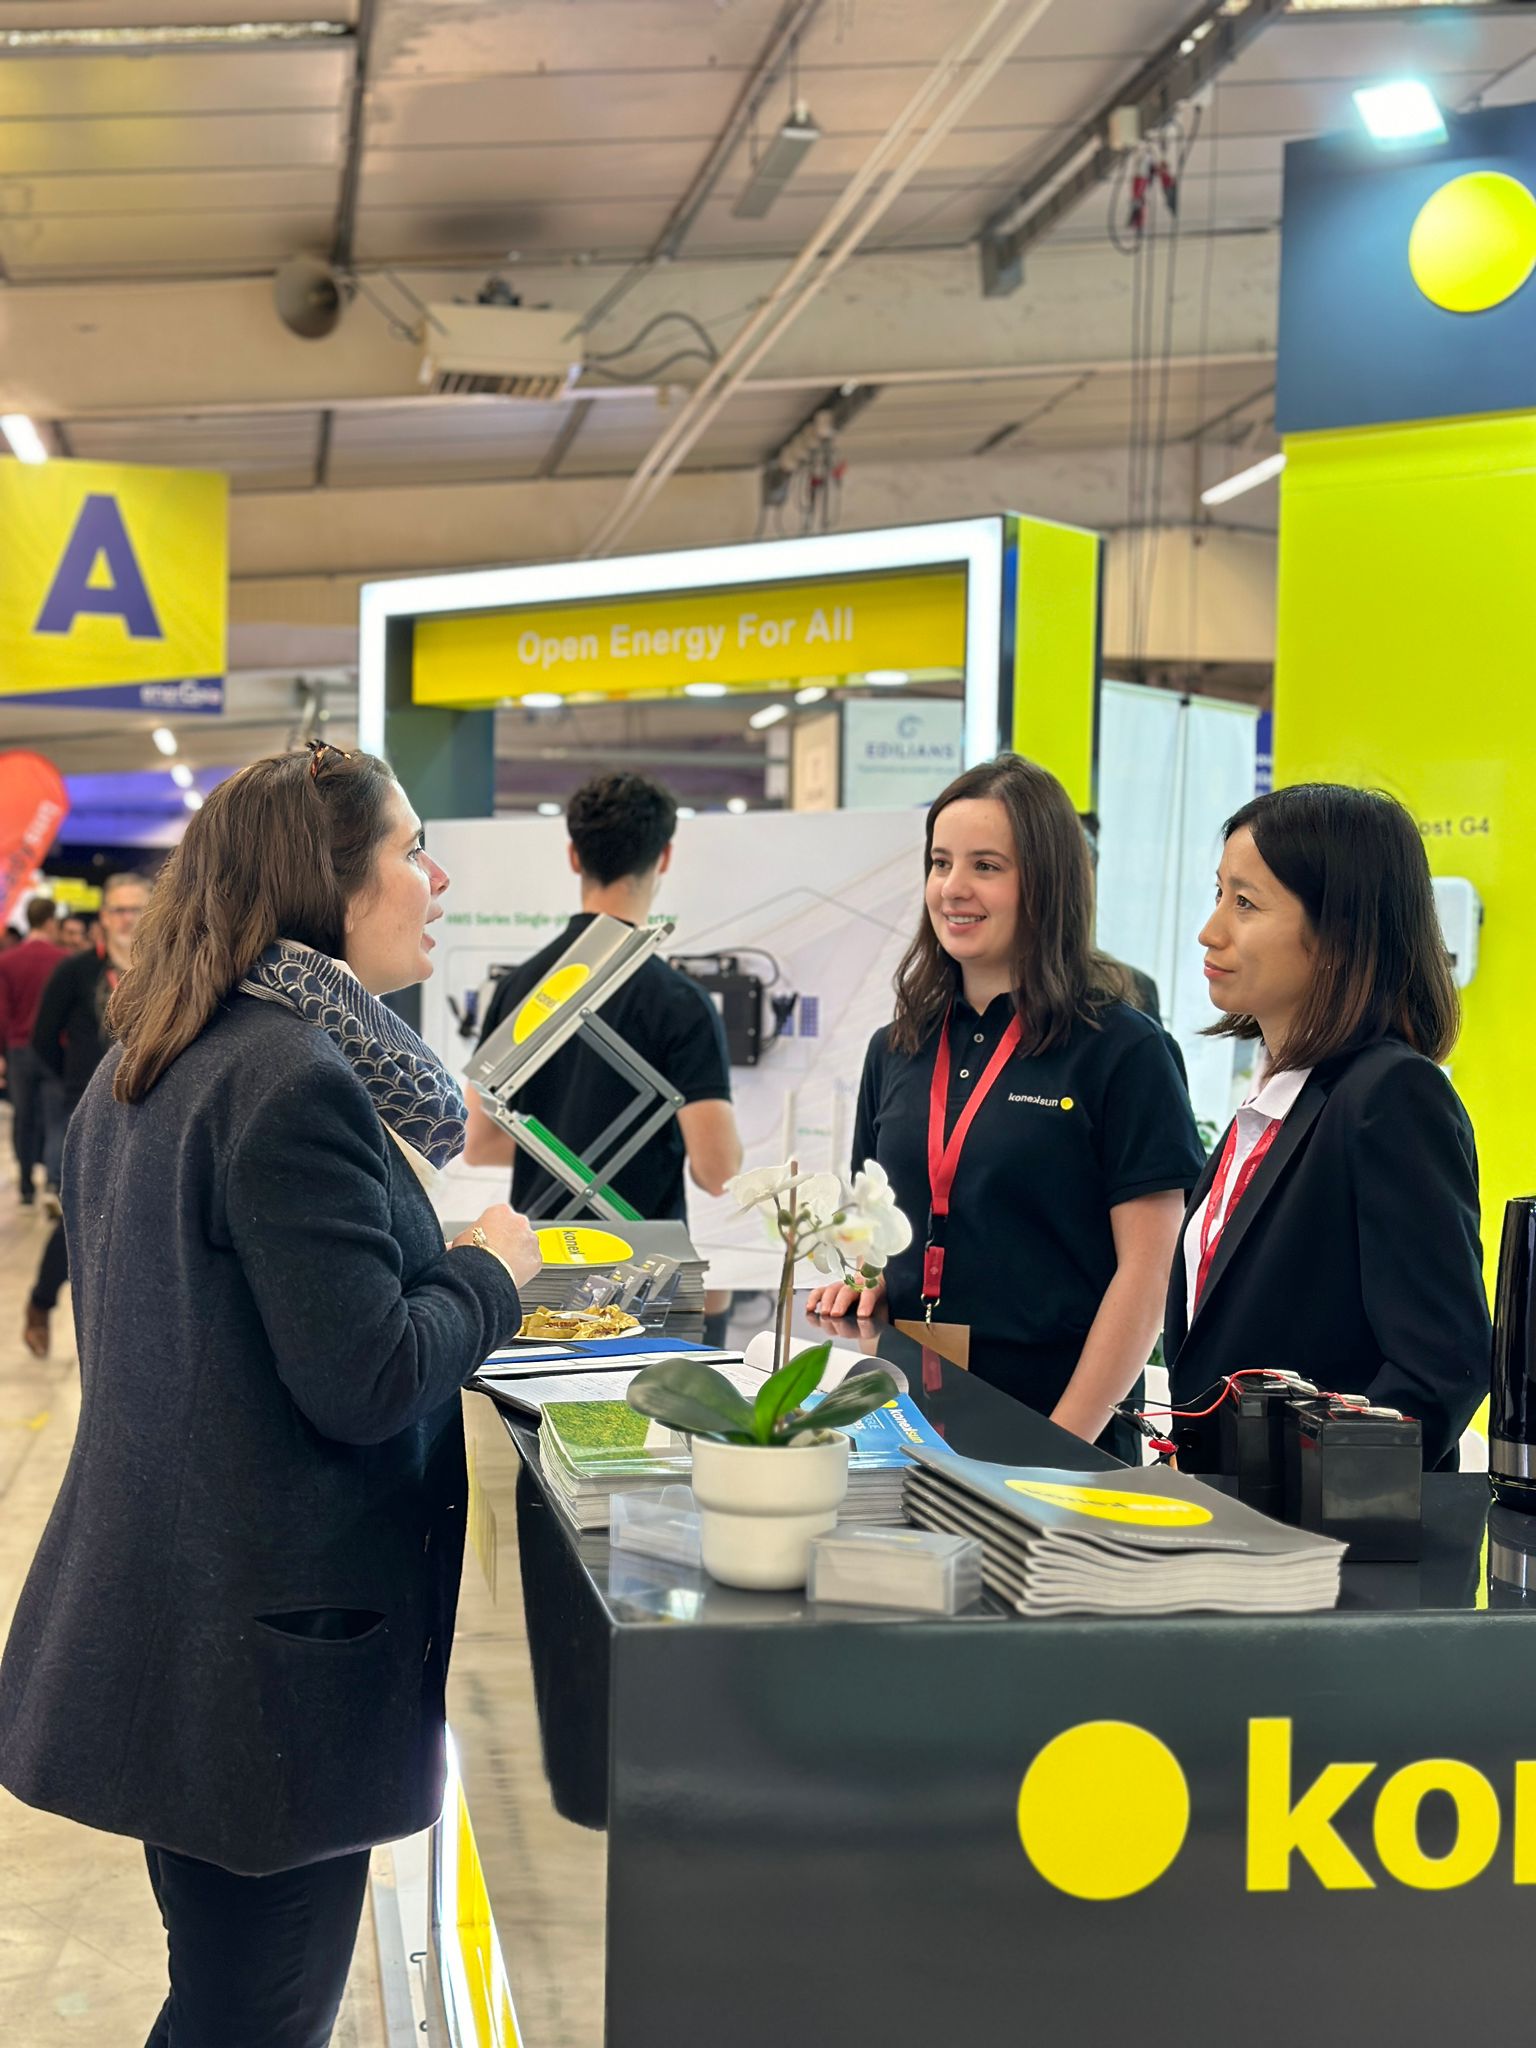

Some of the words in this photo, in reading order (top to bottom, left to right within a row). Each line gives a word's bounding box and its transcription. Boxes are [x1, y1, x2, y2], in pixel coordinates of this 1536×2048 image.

[34, 493, 165, 640] A
[517, 630, 599, 670] Open
[610, 624, 726, 662] Energy
[737, 613, 797, 649] For
[805, 606, 854, 645] All
[865, 741, 955, 759] EDILIANS
[1419, 819, 1452, 836] ost
[1460, 815, 1490, 836] G4
[477, 912, 510, 925] Series
[648, 913, 678, 925] erter
[1247, 1717, 1536, 1891] ko
